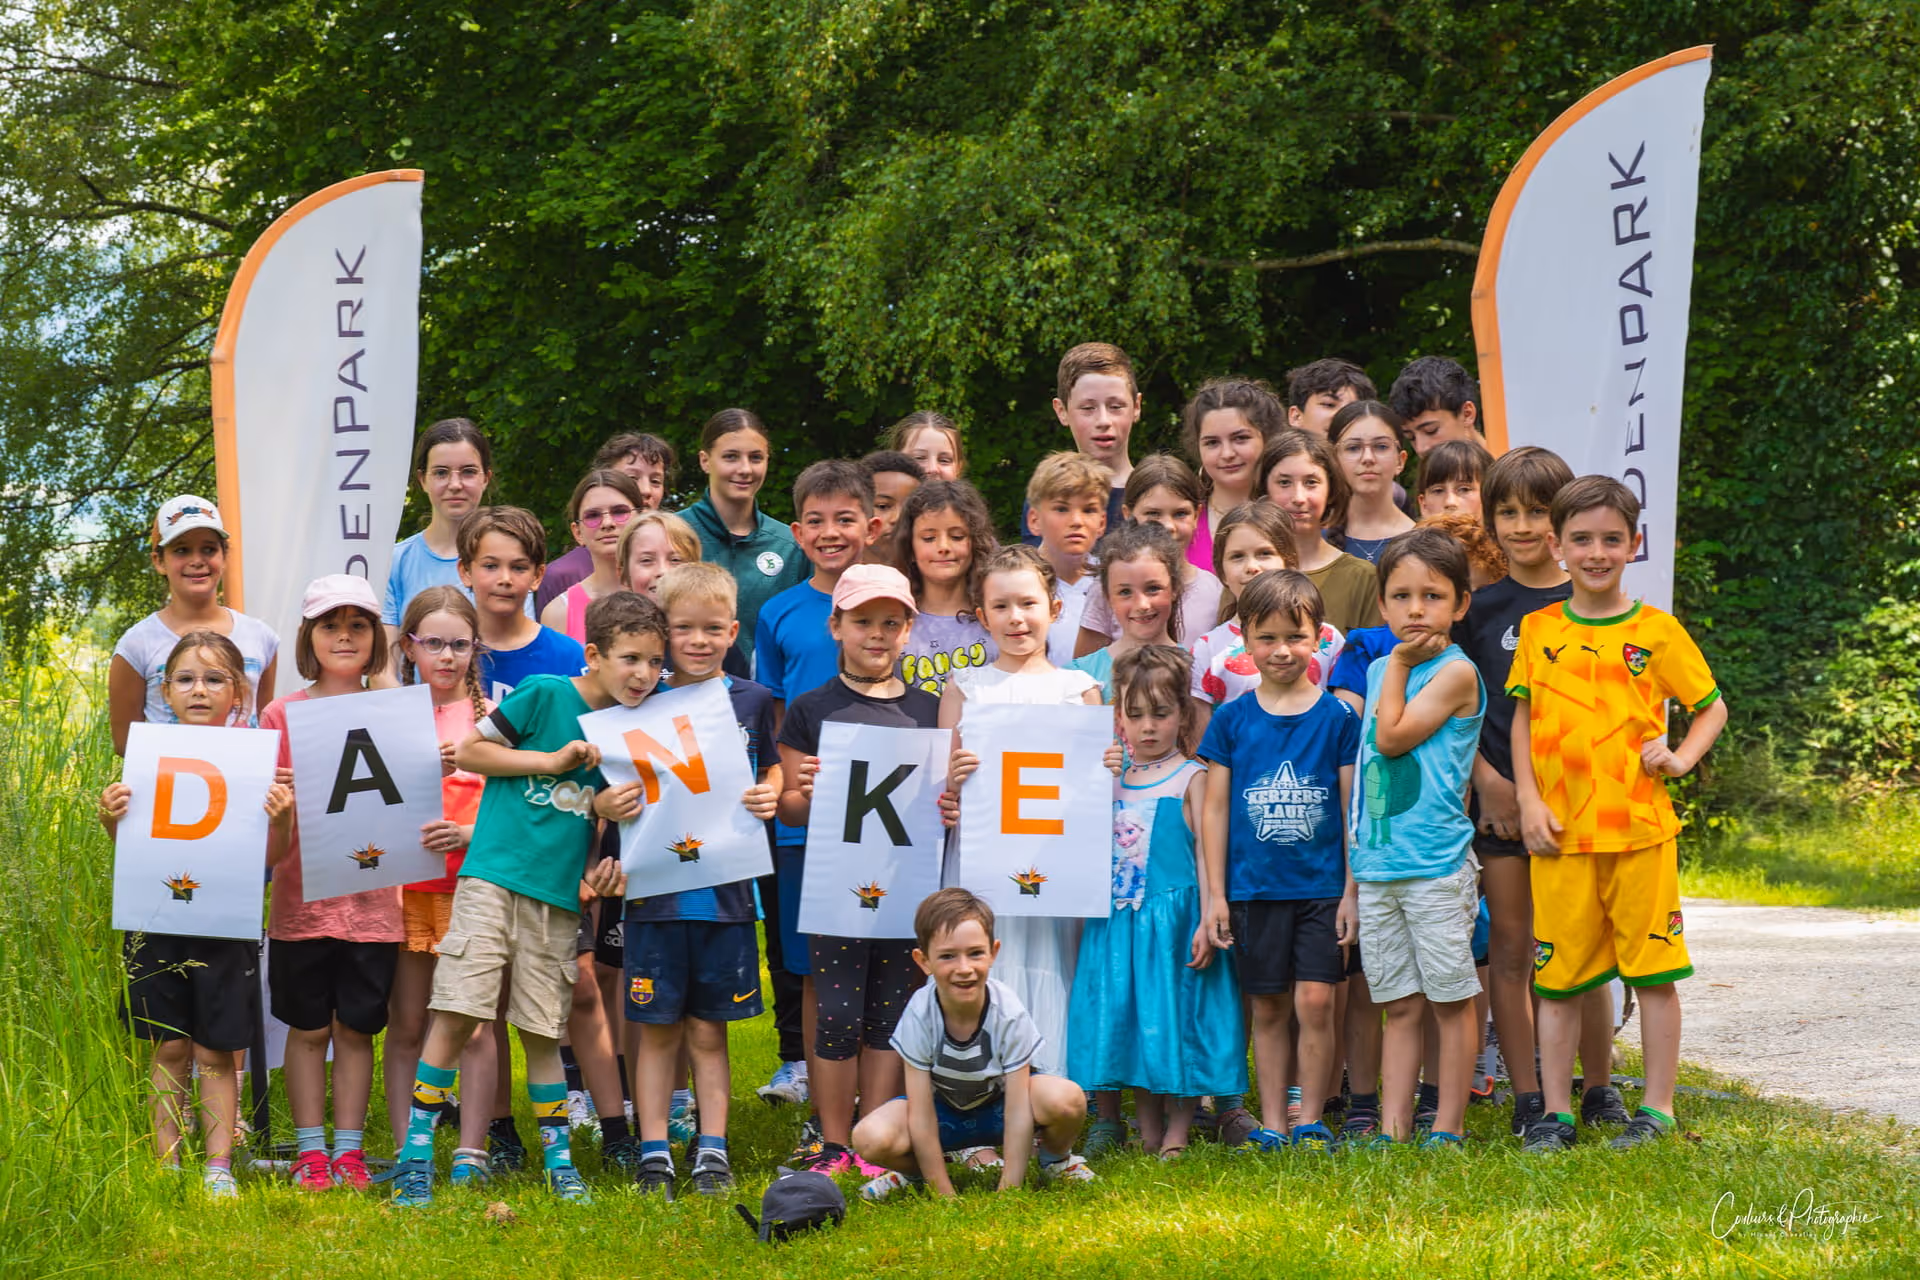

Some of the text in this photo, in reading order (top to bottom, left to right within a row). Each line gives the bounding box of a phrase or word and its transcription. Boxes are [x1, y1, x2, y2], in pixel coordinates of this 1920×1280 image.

[333, 244, 372, 581] DENPARK
[149, 757, 228, 841] D
[326, 728, 404, 815] A
[623, 715, 711, 805] N
[842, 760, 919, 847] K
[1000, 751, 1065, 835] E
[1262, 804, 1307, 819] LAUF
